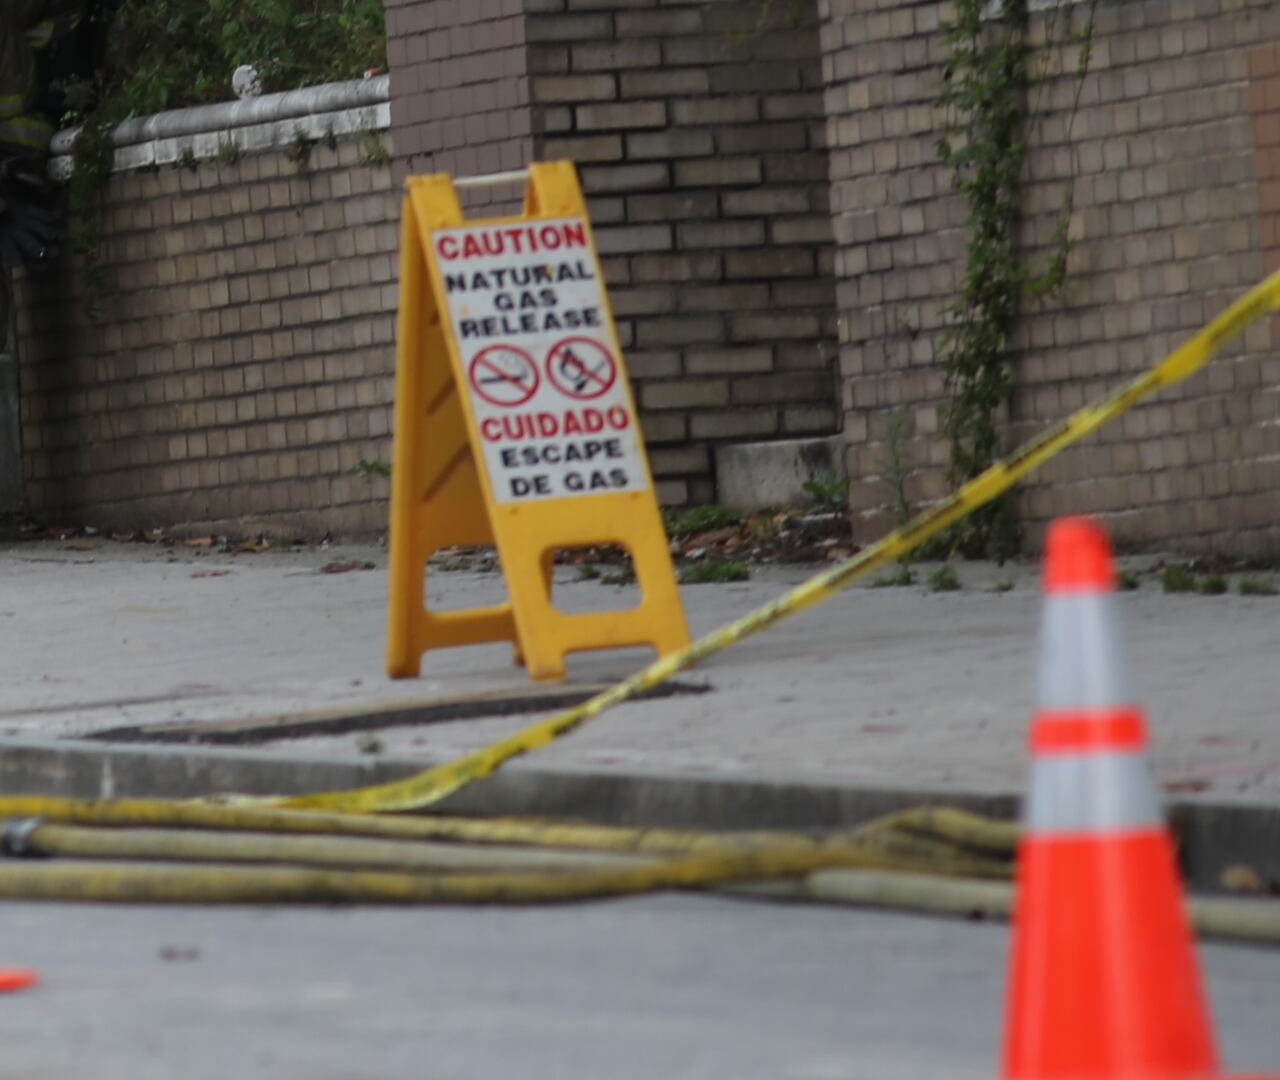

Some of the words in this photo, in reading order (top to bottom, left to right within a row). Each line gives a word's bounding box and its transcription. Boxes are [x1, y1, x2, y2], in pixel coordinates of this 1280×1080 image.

[437, 223, 587, 261] CAUTION
[445, 261, 594, 294] NATURAL
[494, 289, 559, 311] GAS
[459, 308, 602, 339] RELEASE
[480, 405, 630, 442] CUIDADO
[500, 438, 624, 468] ESCAPE
[510, 475, 551, 498] DE
[564, 469, 629, 492] GAS
